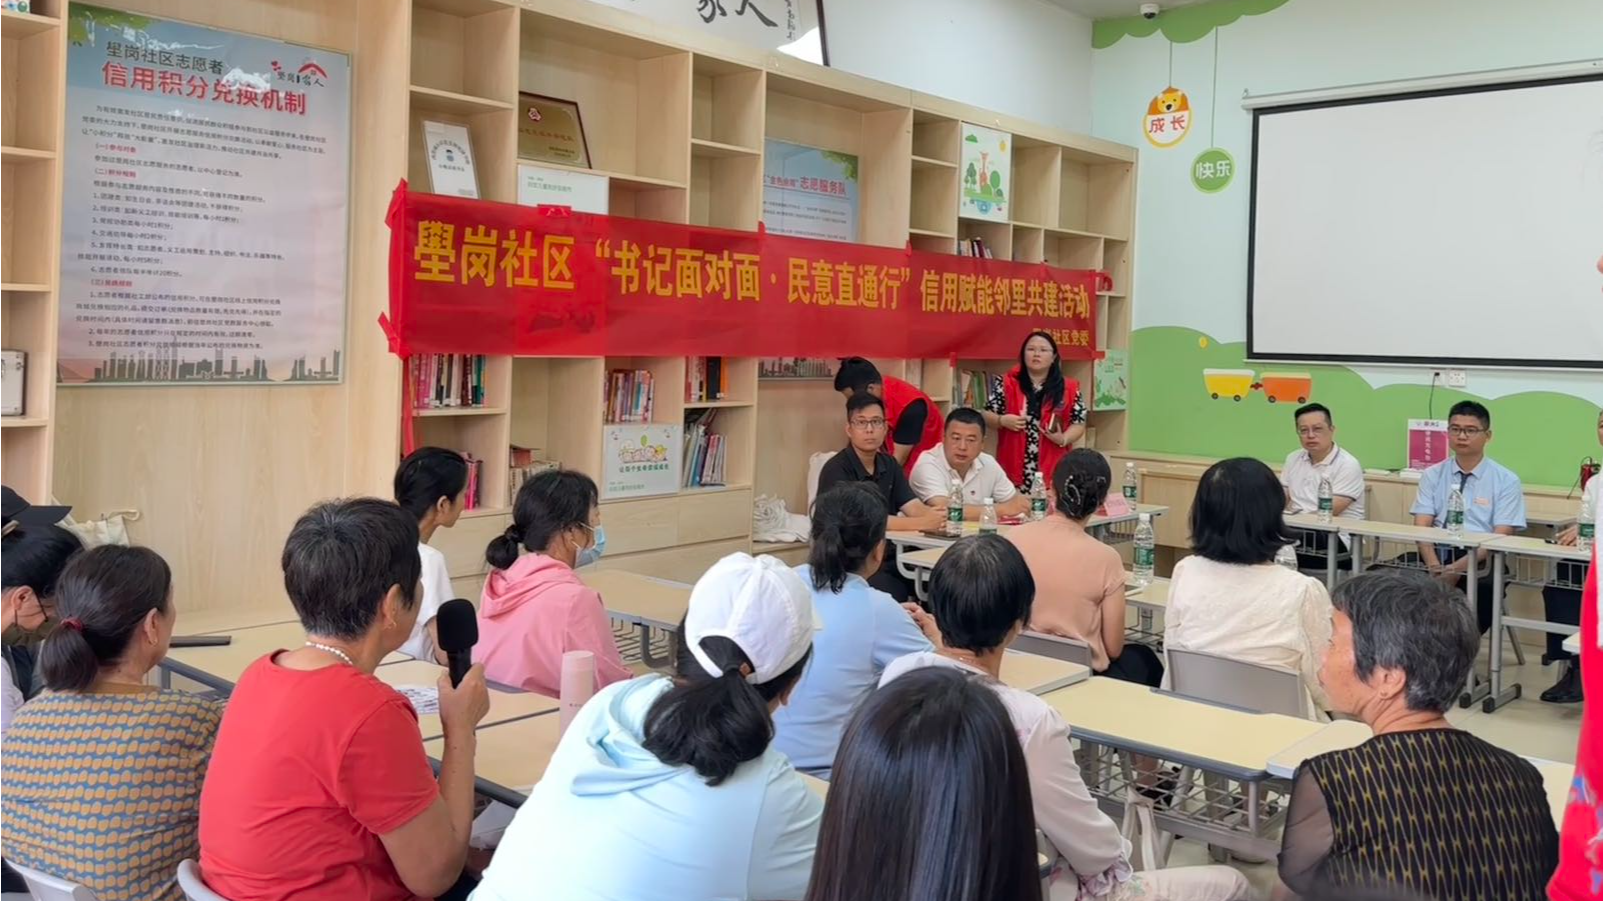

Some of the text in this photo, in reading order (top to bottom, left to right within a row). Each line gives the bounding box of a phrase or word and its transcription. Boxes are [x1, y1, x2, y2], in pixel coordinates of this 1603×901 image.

[102, 61, 306, 115] 信用积分兑换机制
[1149, 115, 1185, 133] 成长
[1196, 160, 1231, 180] 快乐
[414, 220, 575, 290] 壆岗社区
[920, 269, 1091, 319] 信用赋能邻里共建活动
[1032, 328, 1090, 347] 社区党委
